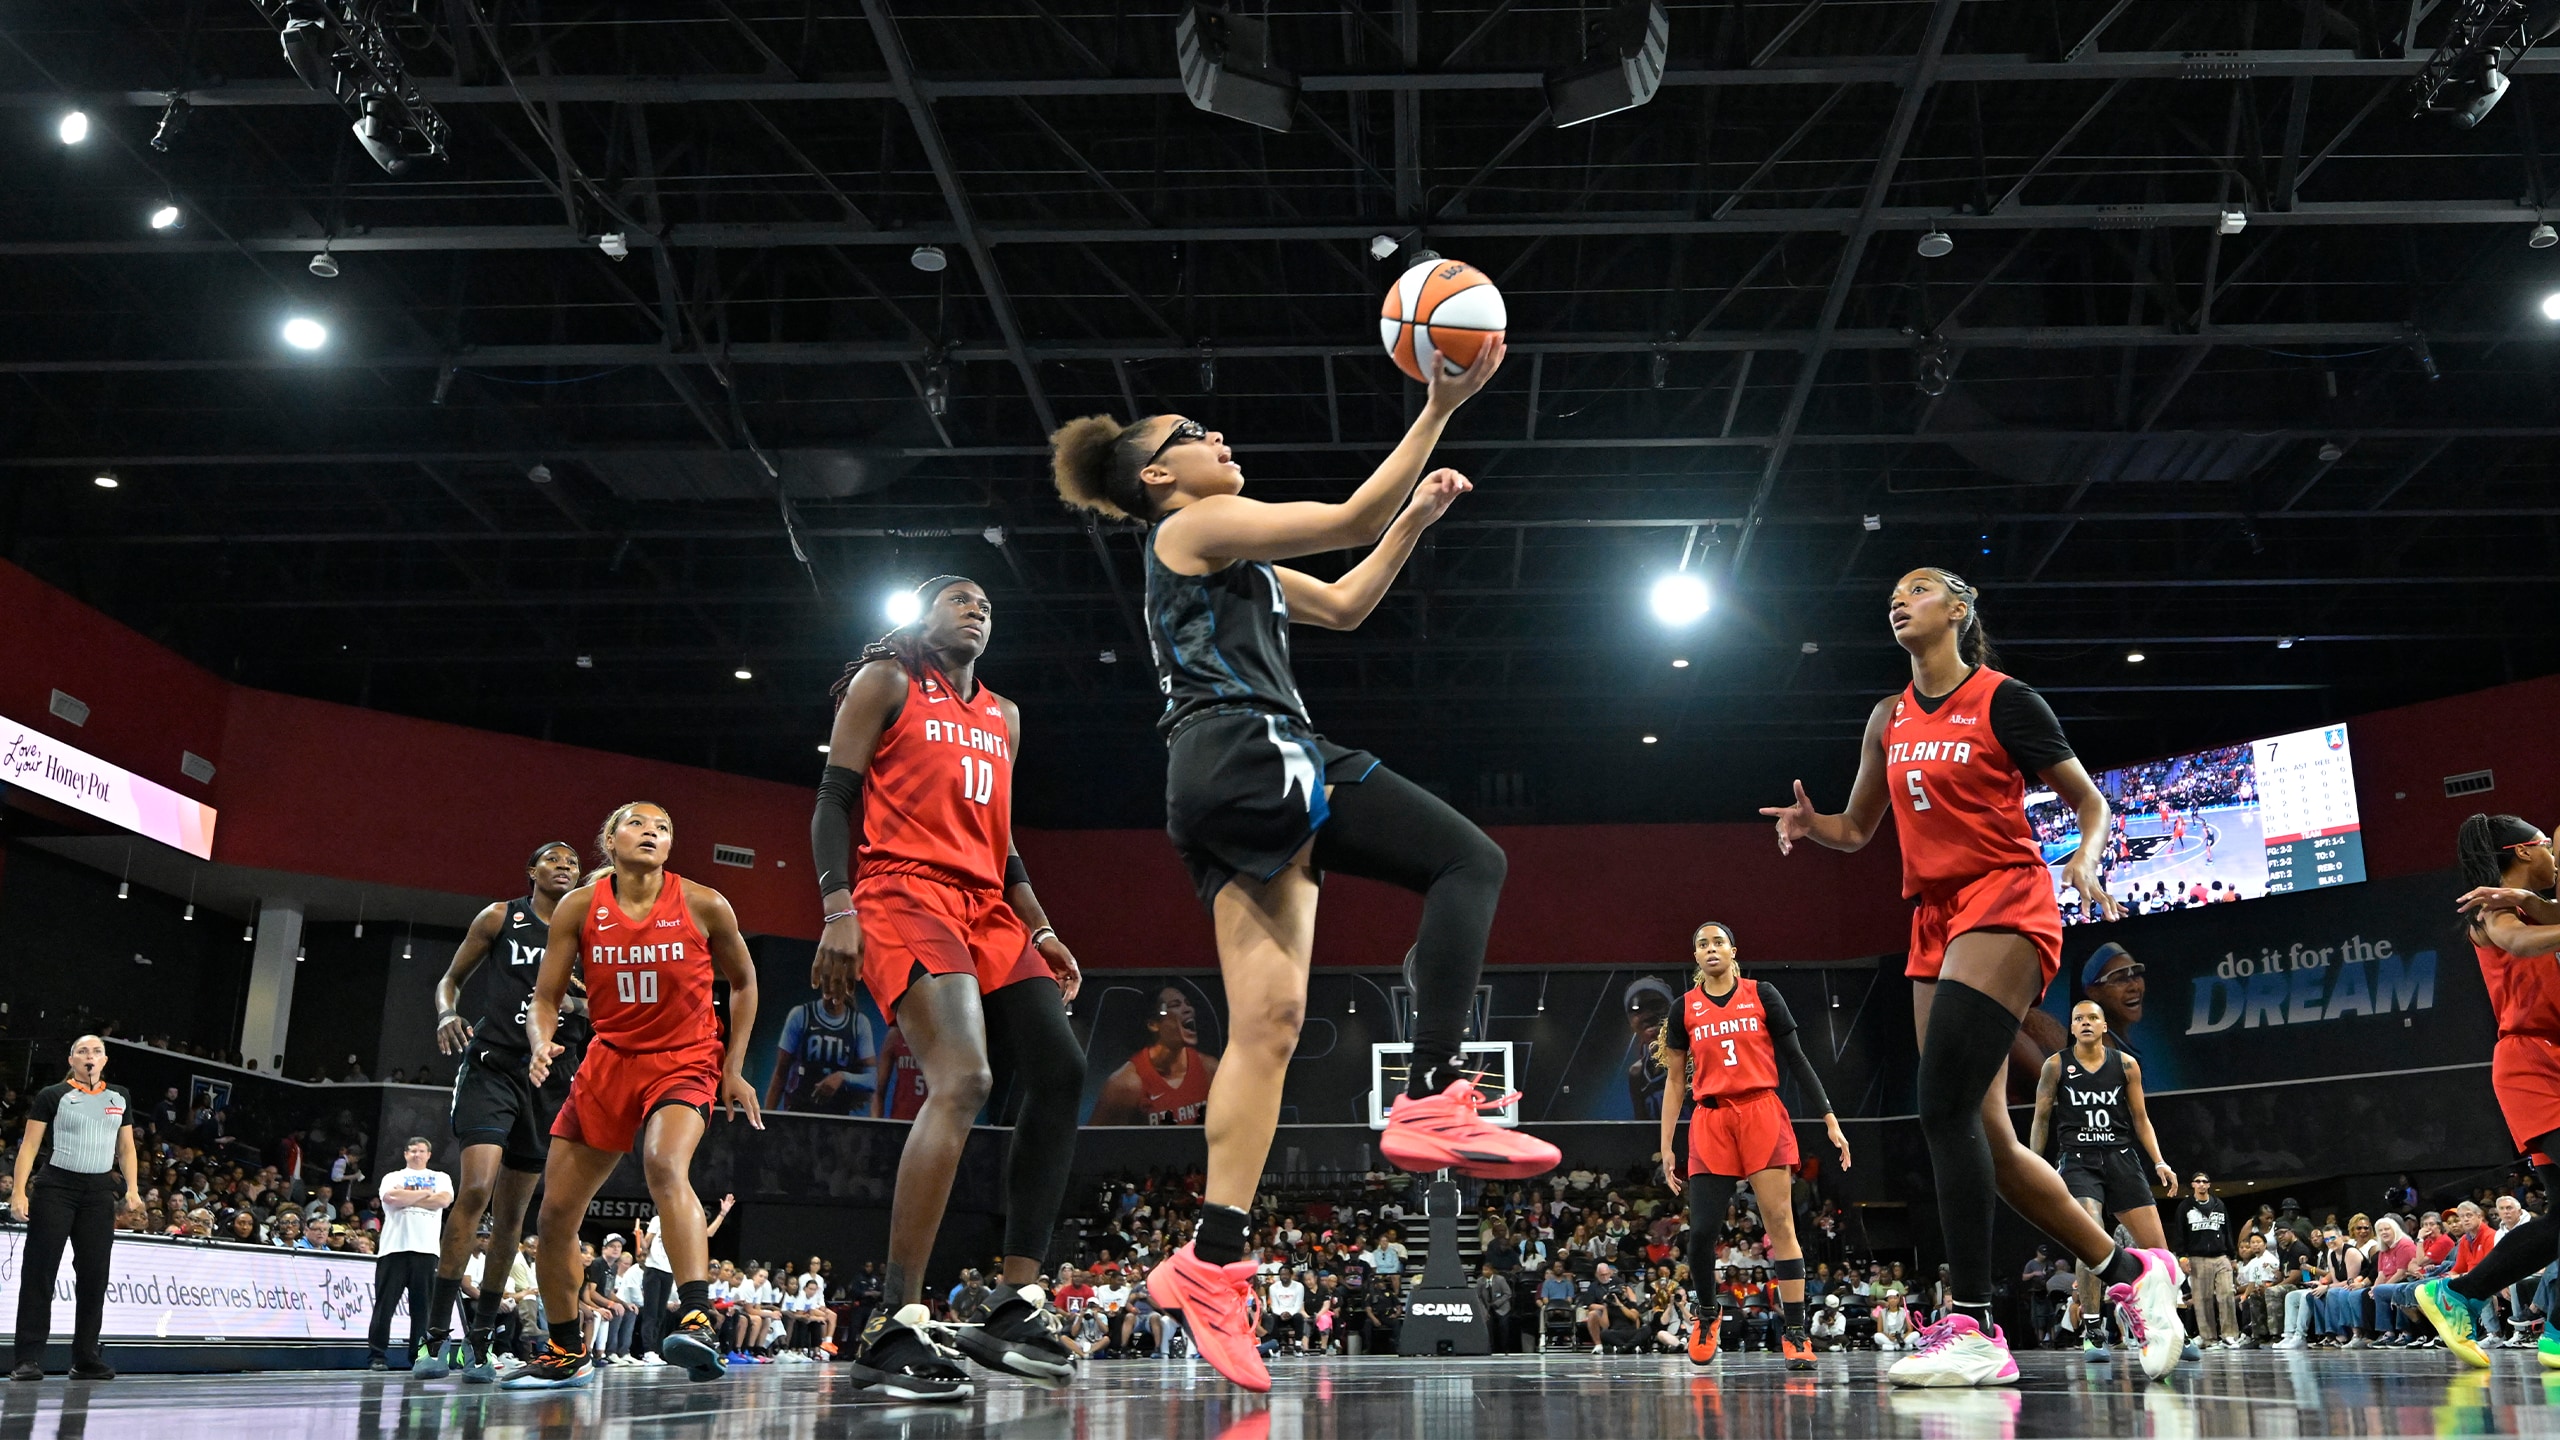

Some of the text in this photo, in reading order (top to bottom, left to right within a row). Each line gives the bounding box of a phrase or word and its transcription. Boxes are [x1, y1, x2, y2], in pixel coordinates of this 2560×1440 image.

[1949, 715, 1976, 724] Albert
[2267, 743, 2278, 762] 7
[15, 755, 110, 803] your Honey Pot
[961, 756, 993, 805] 10
[1906, 770, 1931, 811] 5
[2336, 862, 2343, 870] 0
[655, 919, 681, 928] Albert
[592, 942, 684, 965] ATLANTA
[2217, 935, 2393, 980] do it for the
[617, 971, 658, 1003] 00
[2185, 950, 2437, 1036] DREAM
[1694, 1017, 1758, 1041] ATLANTA
[807, 1034, 850, 1067] ATL
[1721, 1039, 1737, 1067] 3
[2064, 1085, 2122, 1106] LYNX
[2085, 1109, 2110, 1128] 10
[2077, 1133, 2116, 1141] CLINIC
[106, 1274, 161, 1305] eriod
[167, 1275, 252, 1308] deserves
[253, 1281, 313, 1311] better.
[338, 1296, 363, 1330] your
[1412, 1303, 1473, 1315] SCANA
